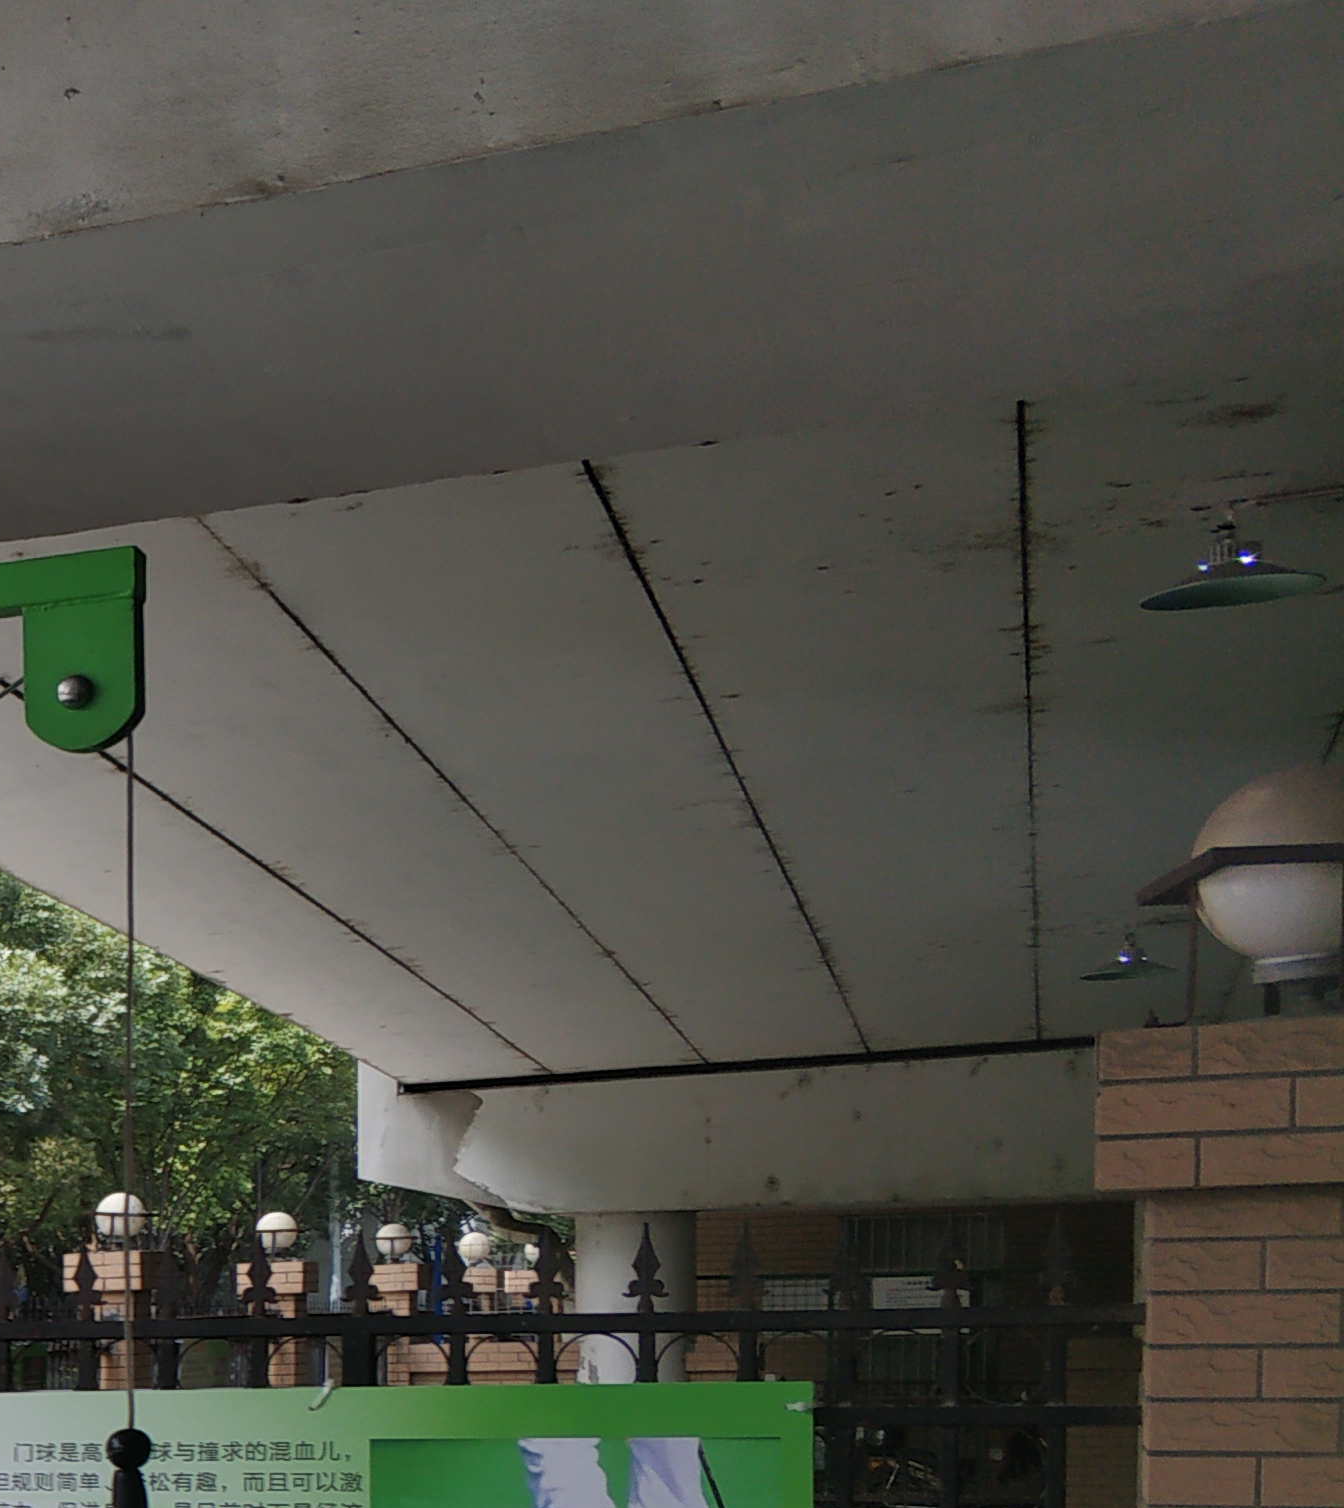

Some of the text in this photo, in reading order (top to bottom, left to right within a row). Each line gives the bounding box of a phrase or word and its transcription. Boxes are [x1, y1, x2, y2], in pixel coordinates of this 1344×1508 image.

[13, 1441, 352, 1464] 门球是高球与撞求的混血儿，
